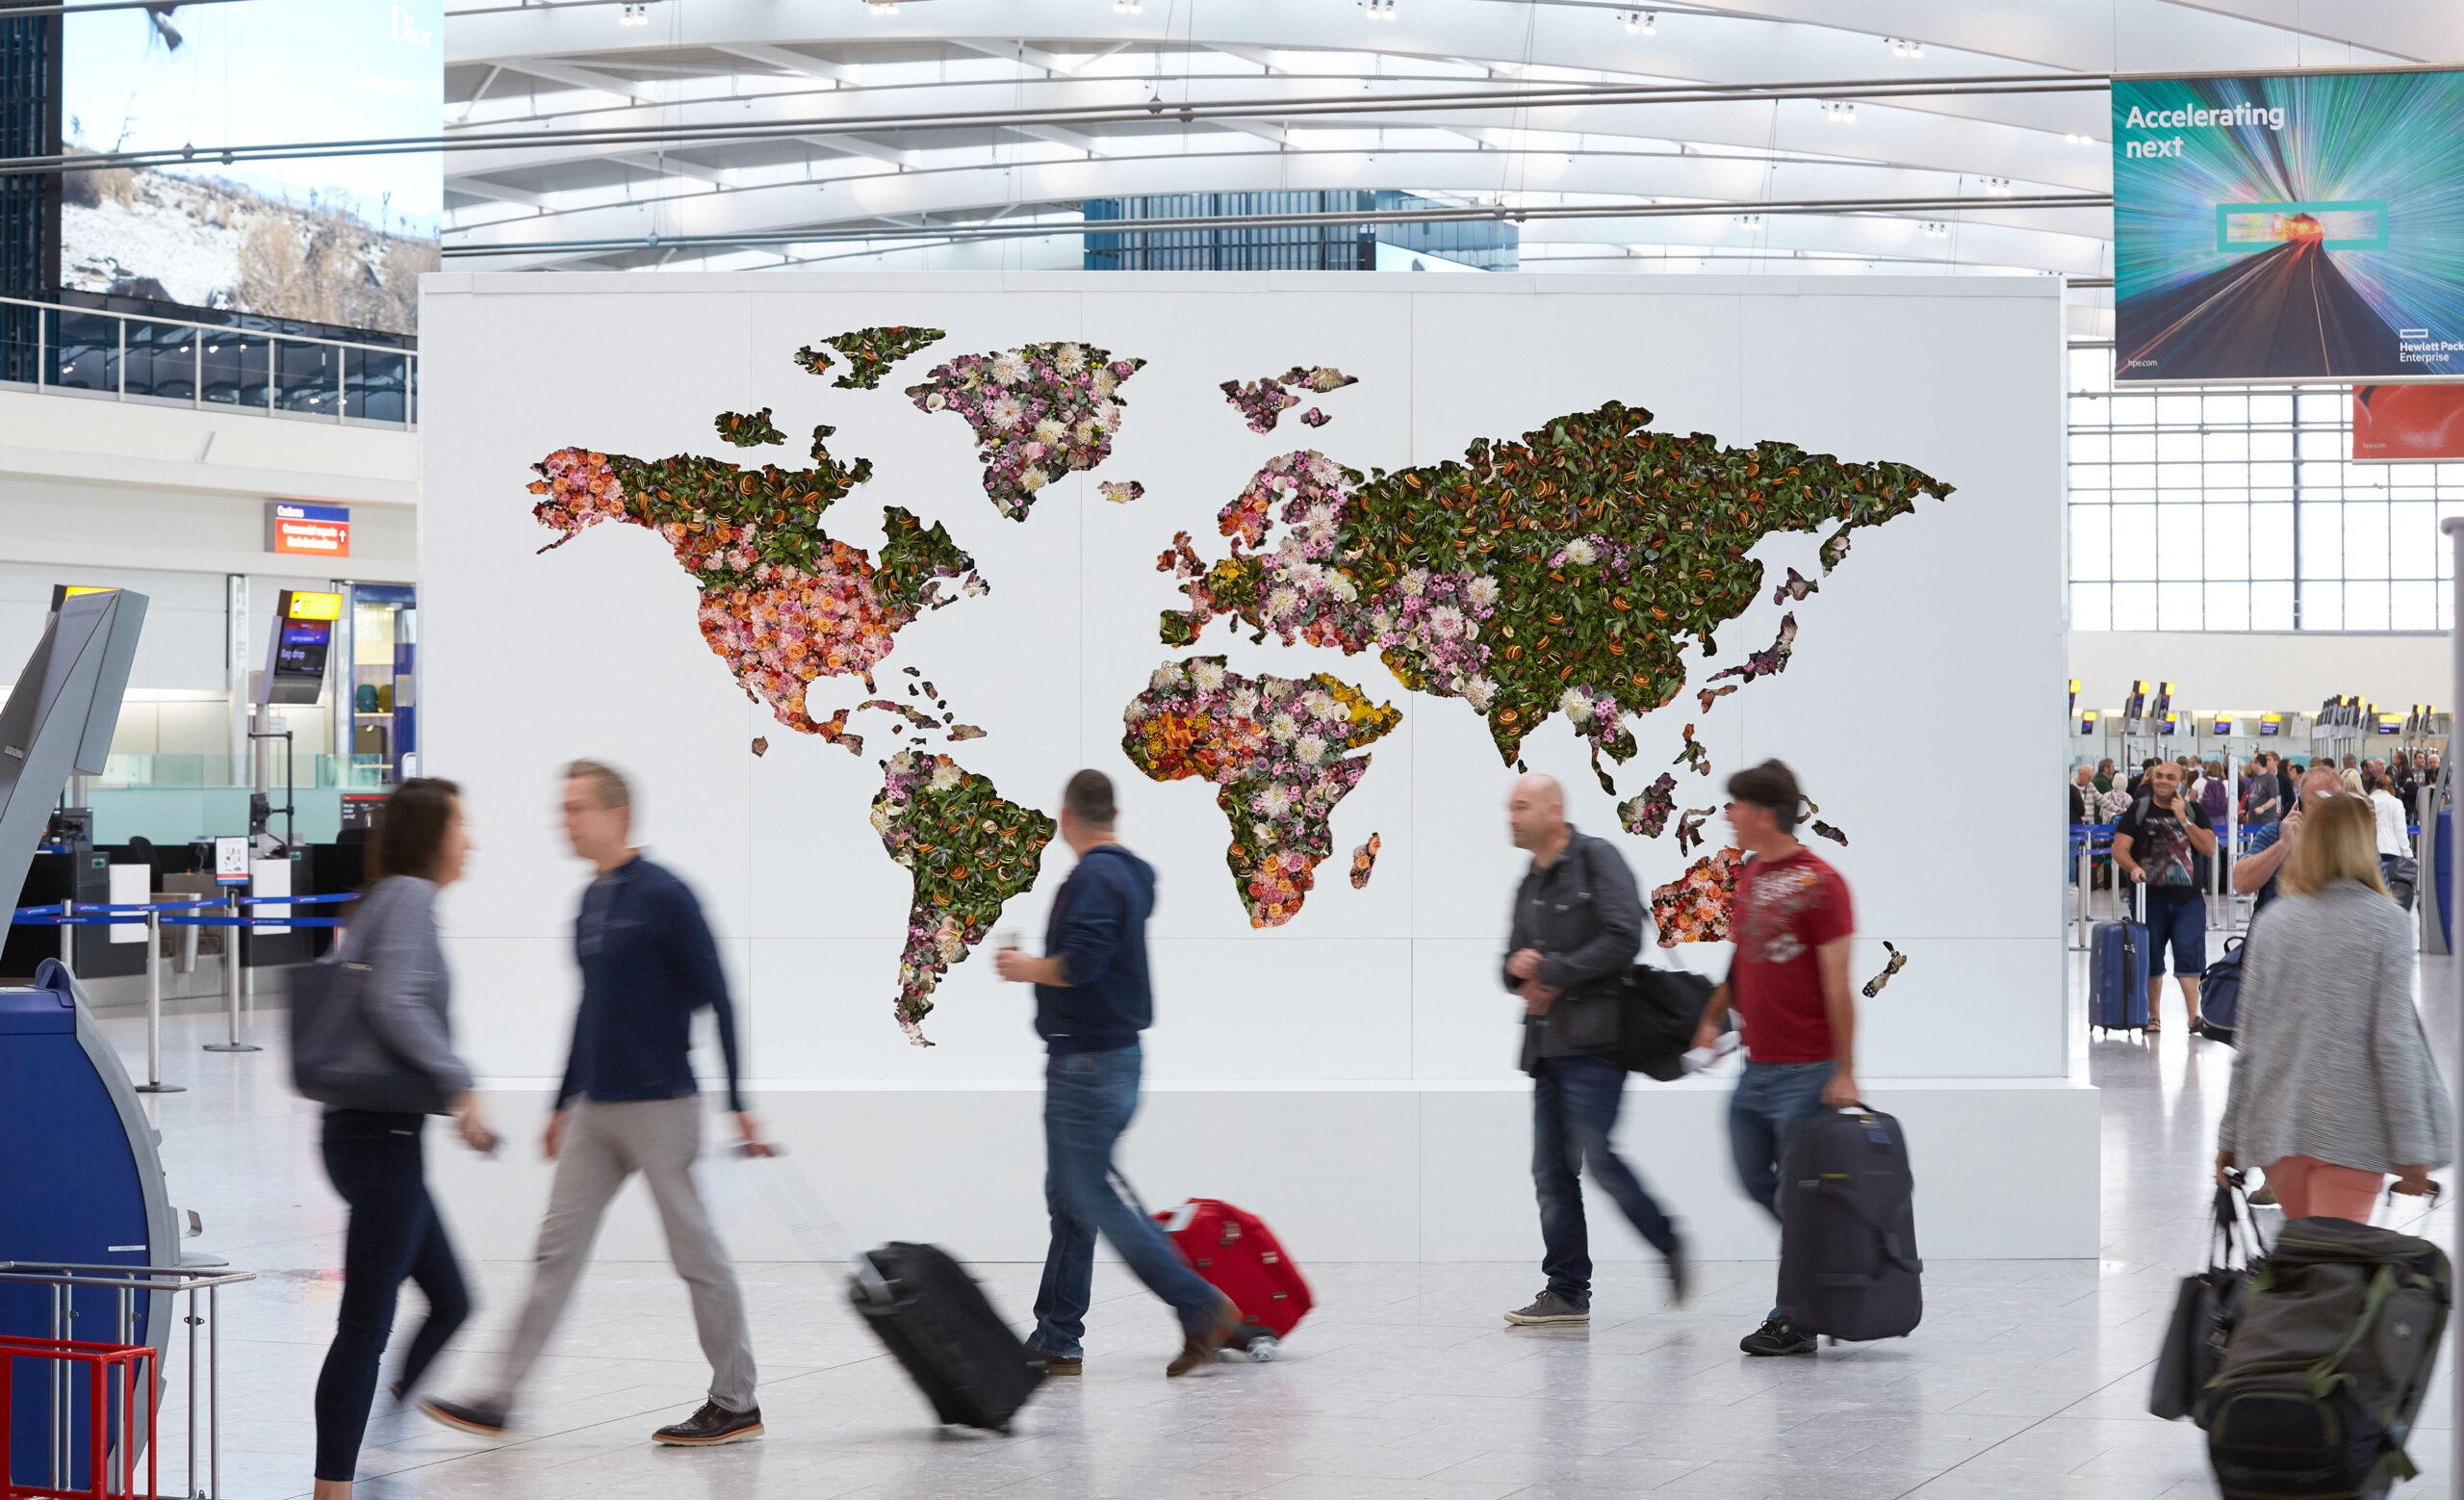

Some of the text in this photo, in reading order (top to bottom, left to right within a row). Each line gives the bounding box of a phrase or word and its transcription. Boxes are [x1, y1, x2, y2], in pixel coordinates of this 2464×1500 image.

[390, 5, 433, 48] Dior
[2125, 102, 2285, 131] Accelerating
[2126, 137, 2184, 158] next
[2400, 341, 2464, 351] Hewlett Pack
[2127, 358, 2158, 368] hpe.com
[2400, 352, 2450, 364] Enterprise
